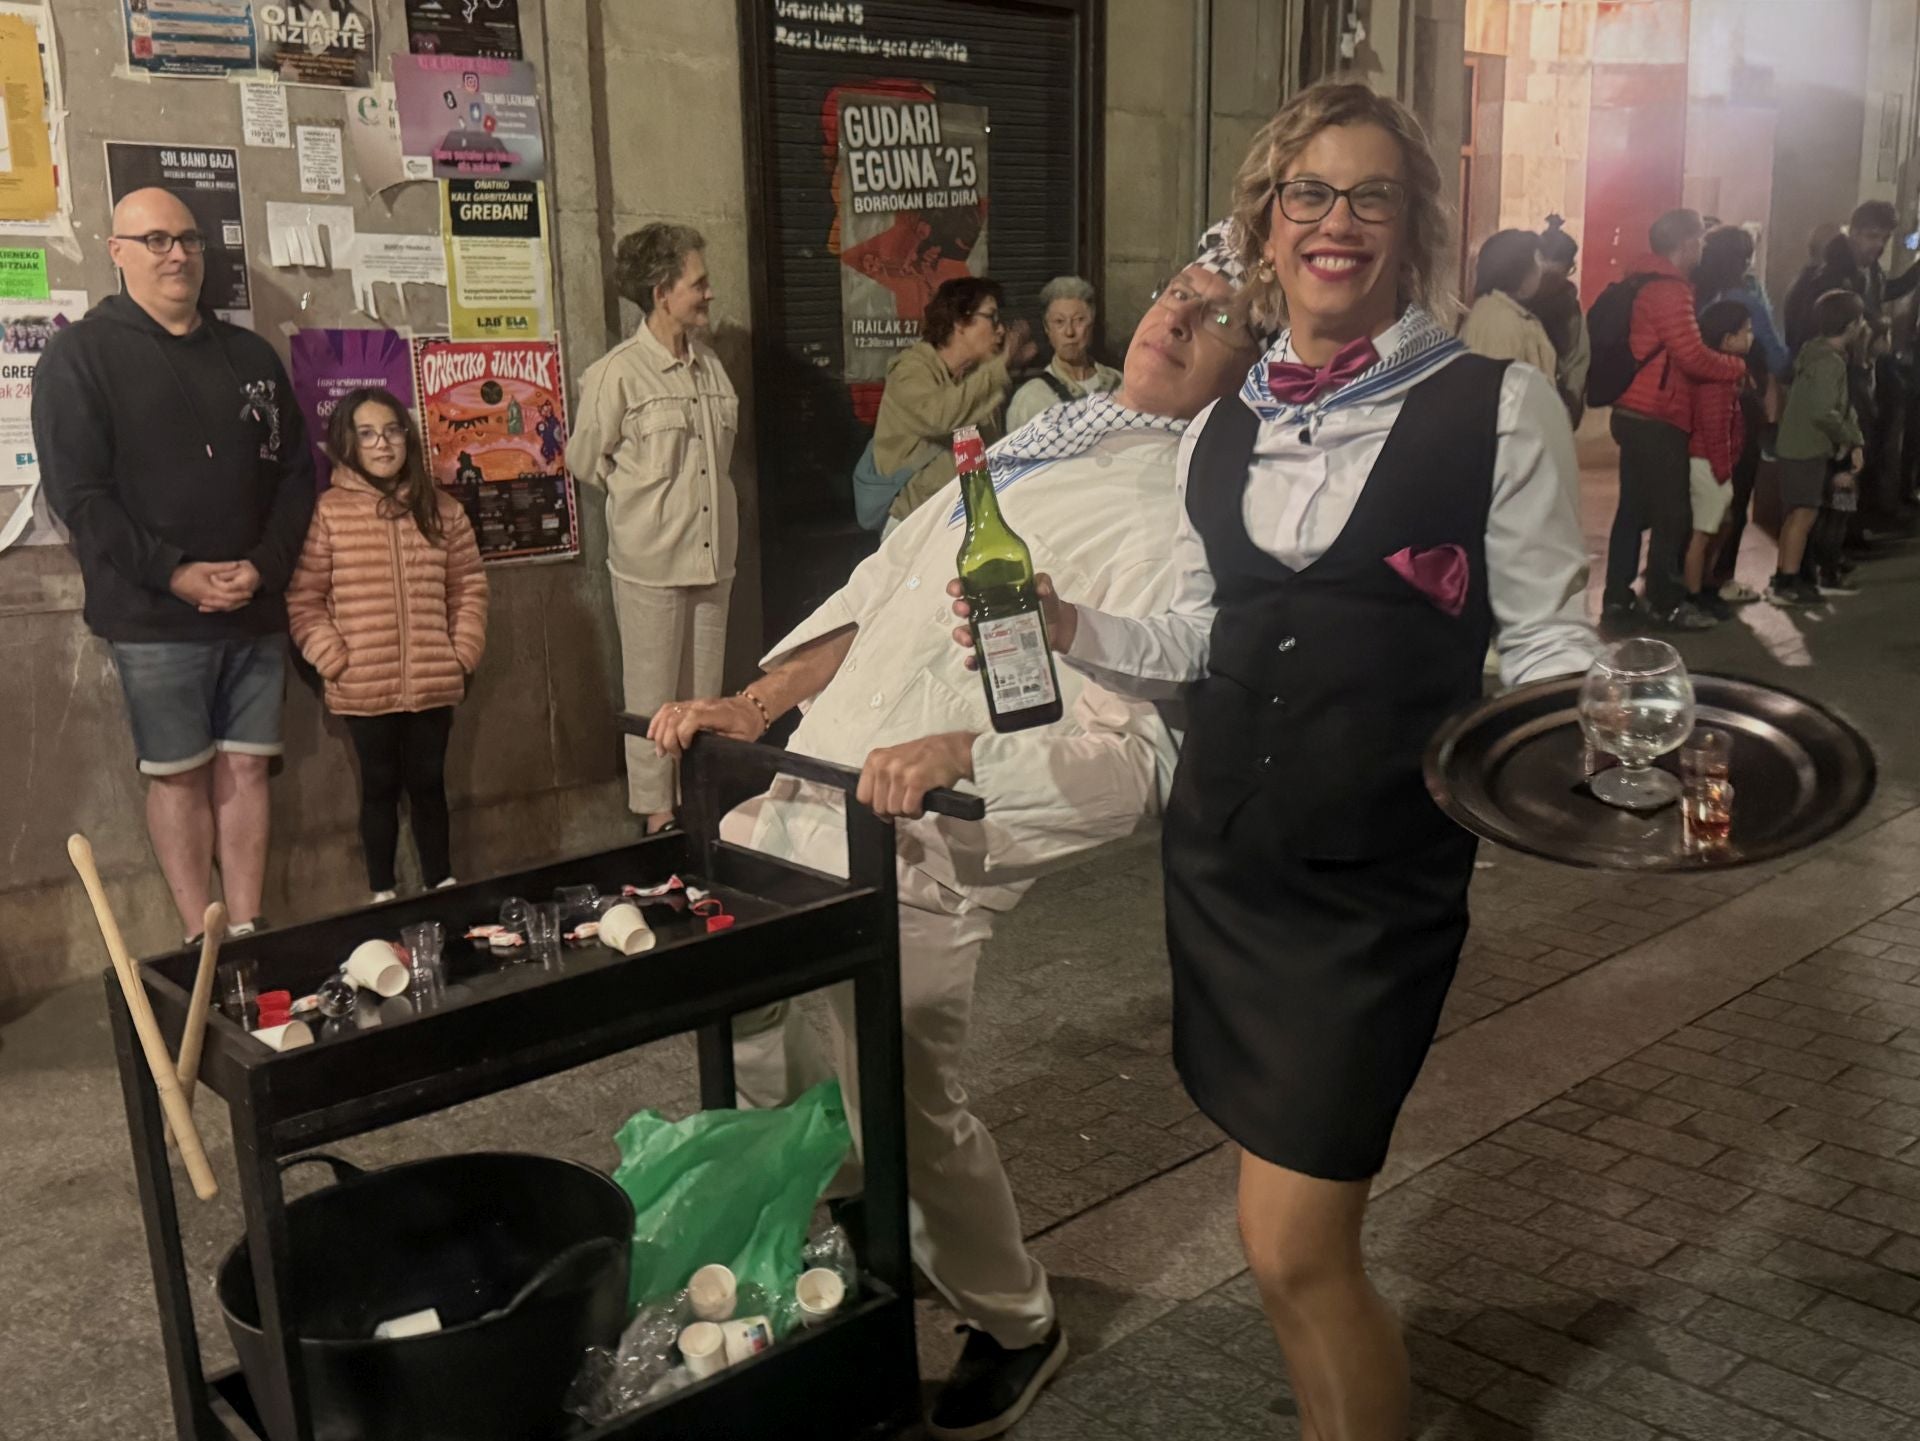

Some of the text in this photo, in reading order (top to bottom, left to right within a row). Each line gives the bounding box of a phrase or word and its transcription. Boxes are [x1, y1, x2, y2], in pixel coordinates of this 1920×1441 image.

[260, 5, 365, 33] OLAIA
[263, 25, 366, 50] INZIARTE
[775, 26, 811, 48] Rosa
[844, 104, 941, 148] GUDARI
[160, 150, 235, 169] SOL BAND GAZA
[451, 192, 472, 202] KALE
[854, 189, 979, 213] BORROKAN BIZI DIRA
[460, 204, 528, 221] GREBAN!
[852, 320, 918, 334] IRAILAK 27
[2, 365, 36, 379] GREB
[423, 350, 553, 396] OÑATIKO JAIXAK
[0, 384, 13, 398] ak
[16, 452, 36, 465] EL
